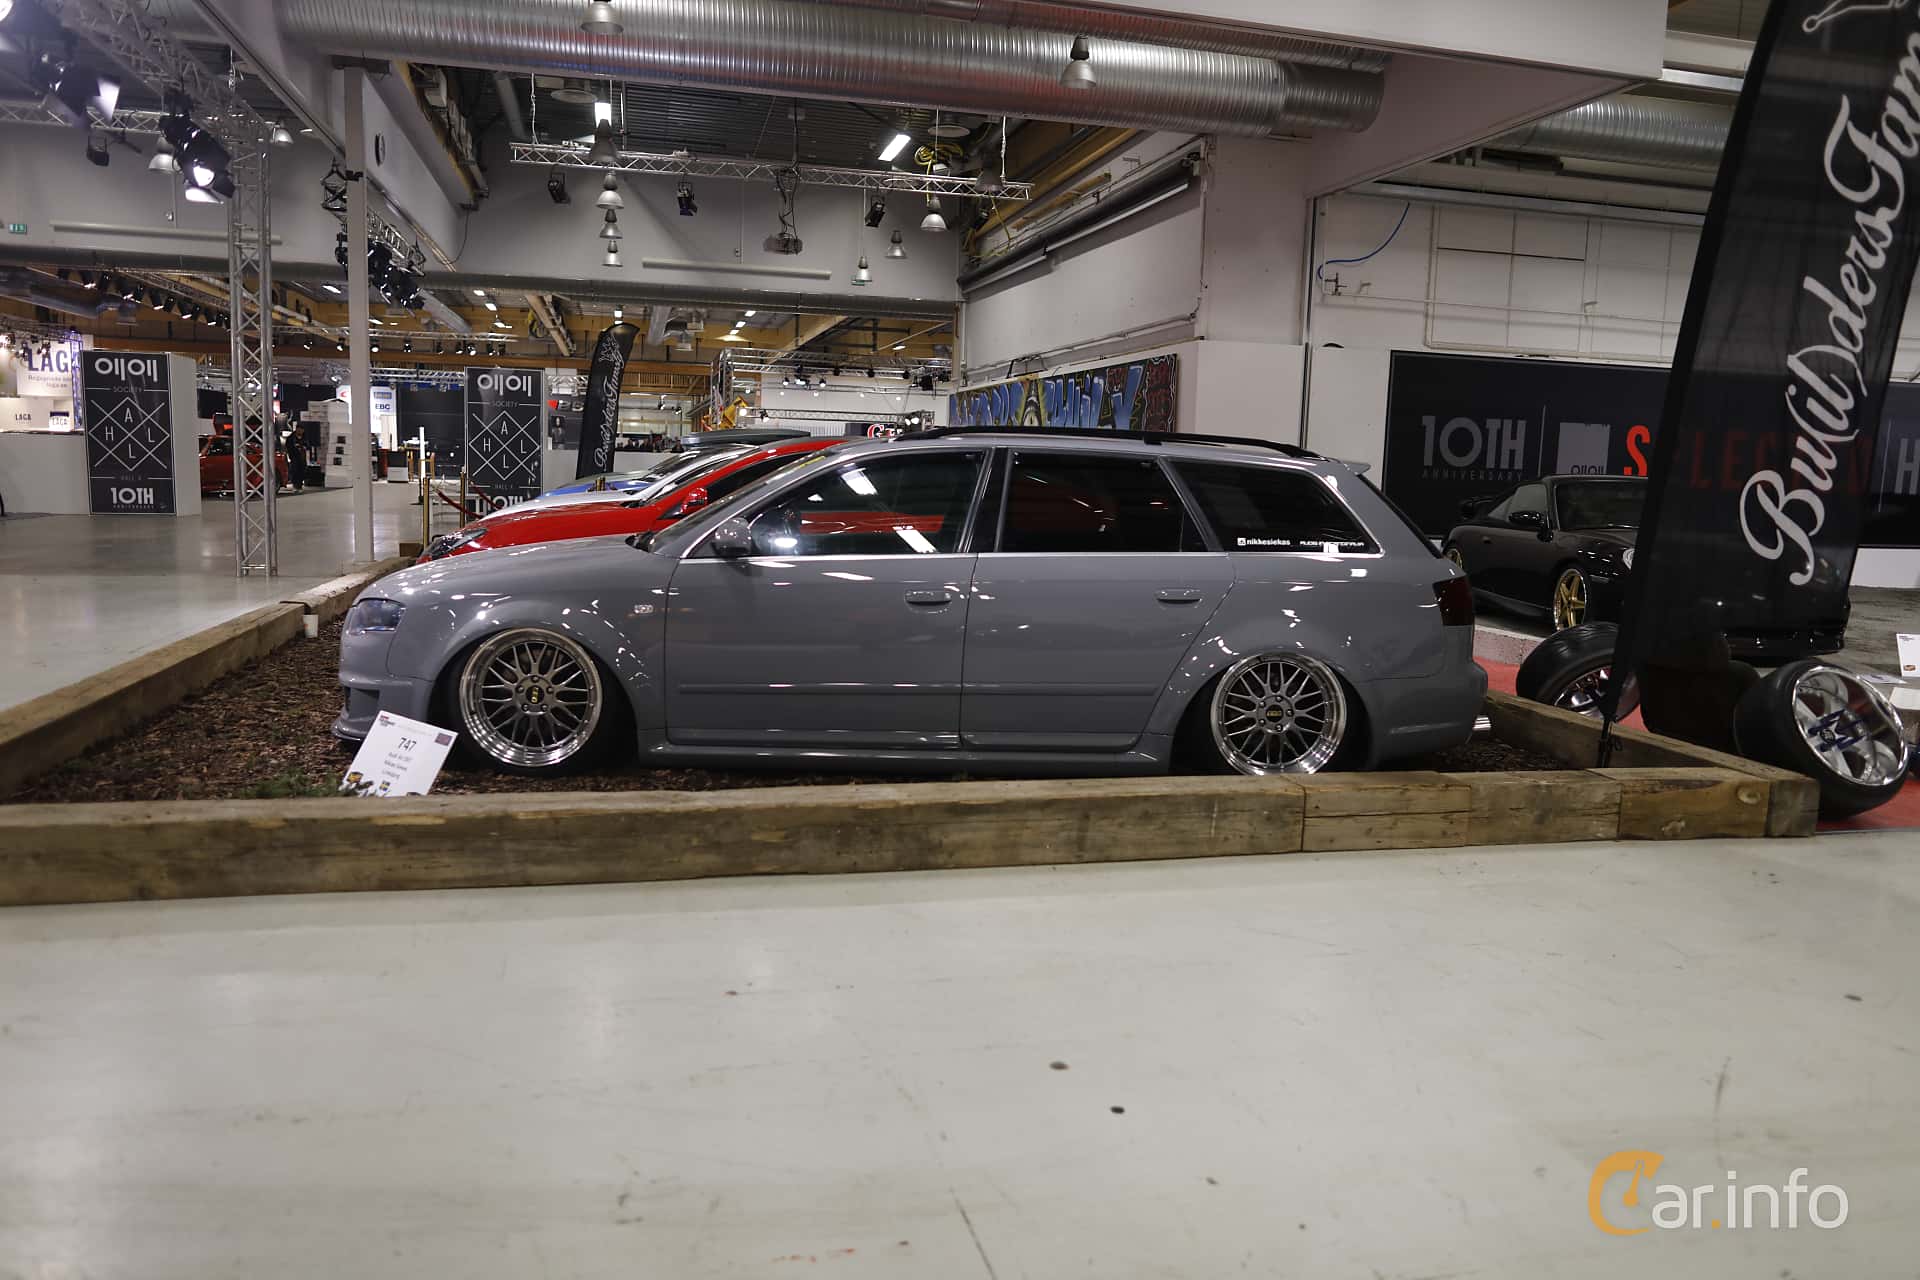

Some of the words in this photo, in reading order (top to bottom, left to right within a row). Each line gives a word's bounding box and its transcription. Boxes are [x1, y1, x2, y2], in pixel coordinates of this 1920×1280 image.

[27, 348, 78, 373] LAG
[1421, 415, 1527, 470] 10TH
[1422, 468, 1523, 481] ANNIVERSARY
[111, 487, 154, 505] 10TH
[398, 737, 417, 752] 747
